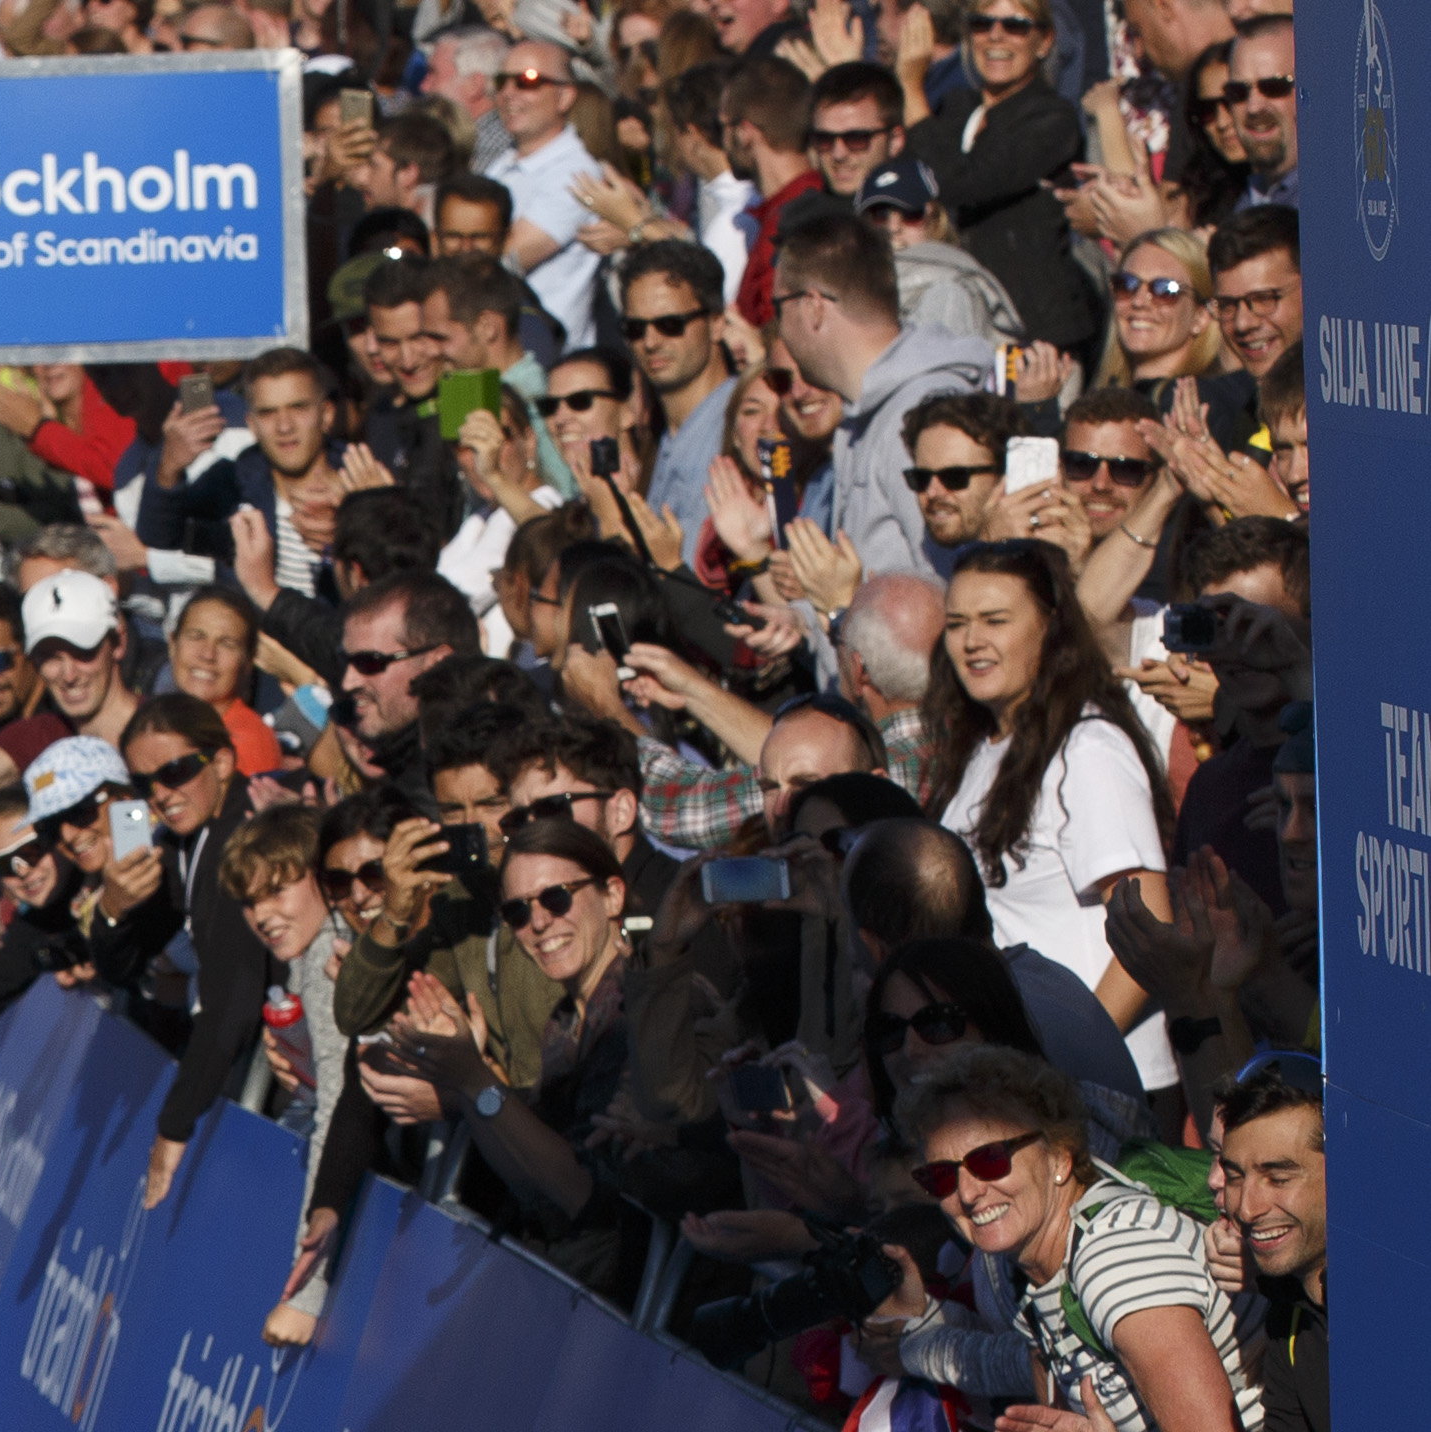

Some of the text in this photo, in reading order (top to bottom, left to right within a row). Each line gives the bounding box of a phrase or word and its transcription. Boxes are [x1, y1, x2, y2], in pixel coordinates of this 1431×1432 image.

[35, 226, 259, 266] Scandinavia
[1319, 314, 1422, 415] SILJA LINE
[1381, 702, 1431, 836] TEA
